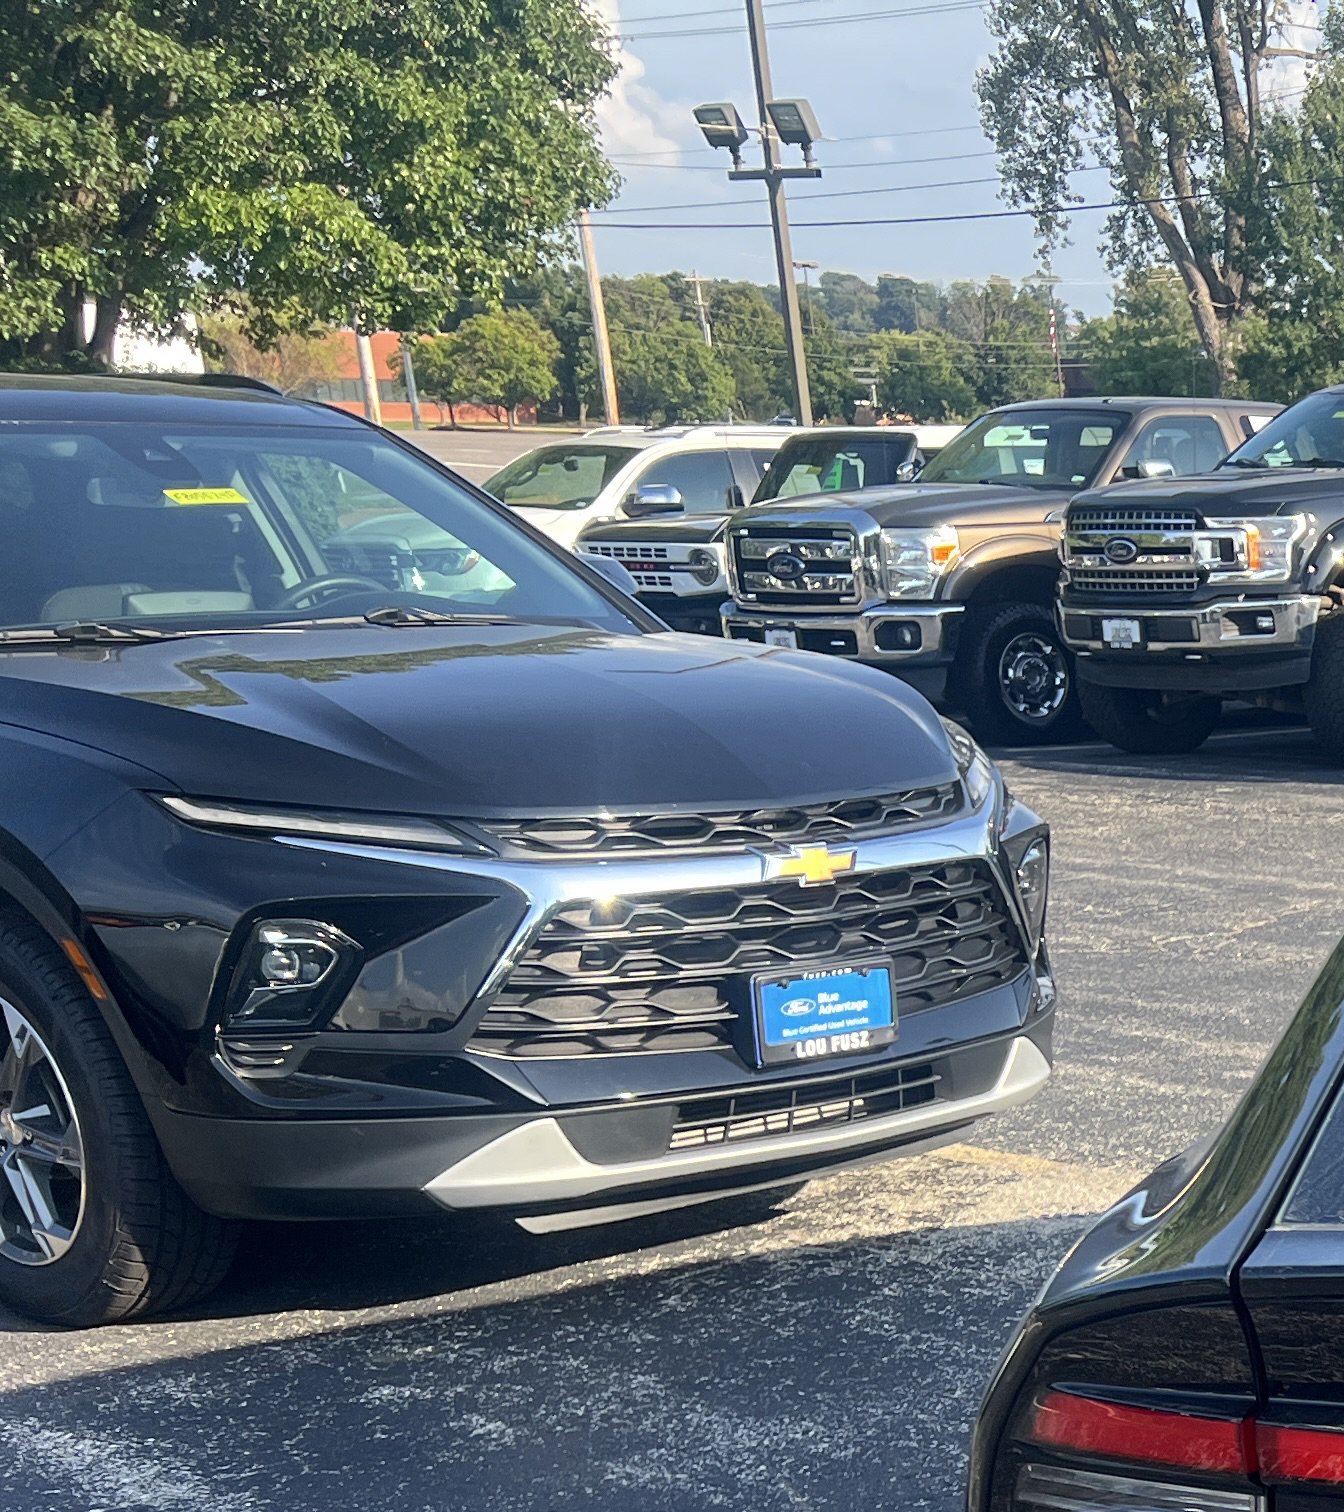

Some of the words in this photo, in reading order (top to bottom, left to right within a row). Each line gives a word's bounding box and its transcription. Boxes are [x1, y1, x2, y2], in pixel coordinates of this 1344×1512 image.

[817, 991, 840, 1004] Blue
[787, 1001, 810, 1015] Ford
[818, 999, 869, 1016] Advantage
[782, 1028, 799, 1038] Blue
[799, 1021, 828, 1034] Certified
[828, 1019, 845, 1030] Used
[845, 1016, 869, 1027] Vehicle
[796, 1037, 827, 1058] LOU
[831, 1030, 870, 1053] FUSZ
